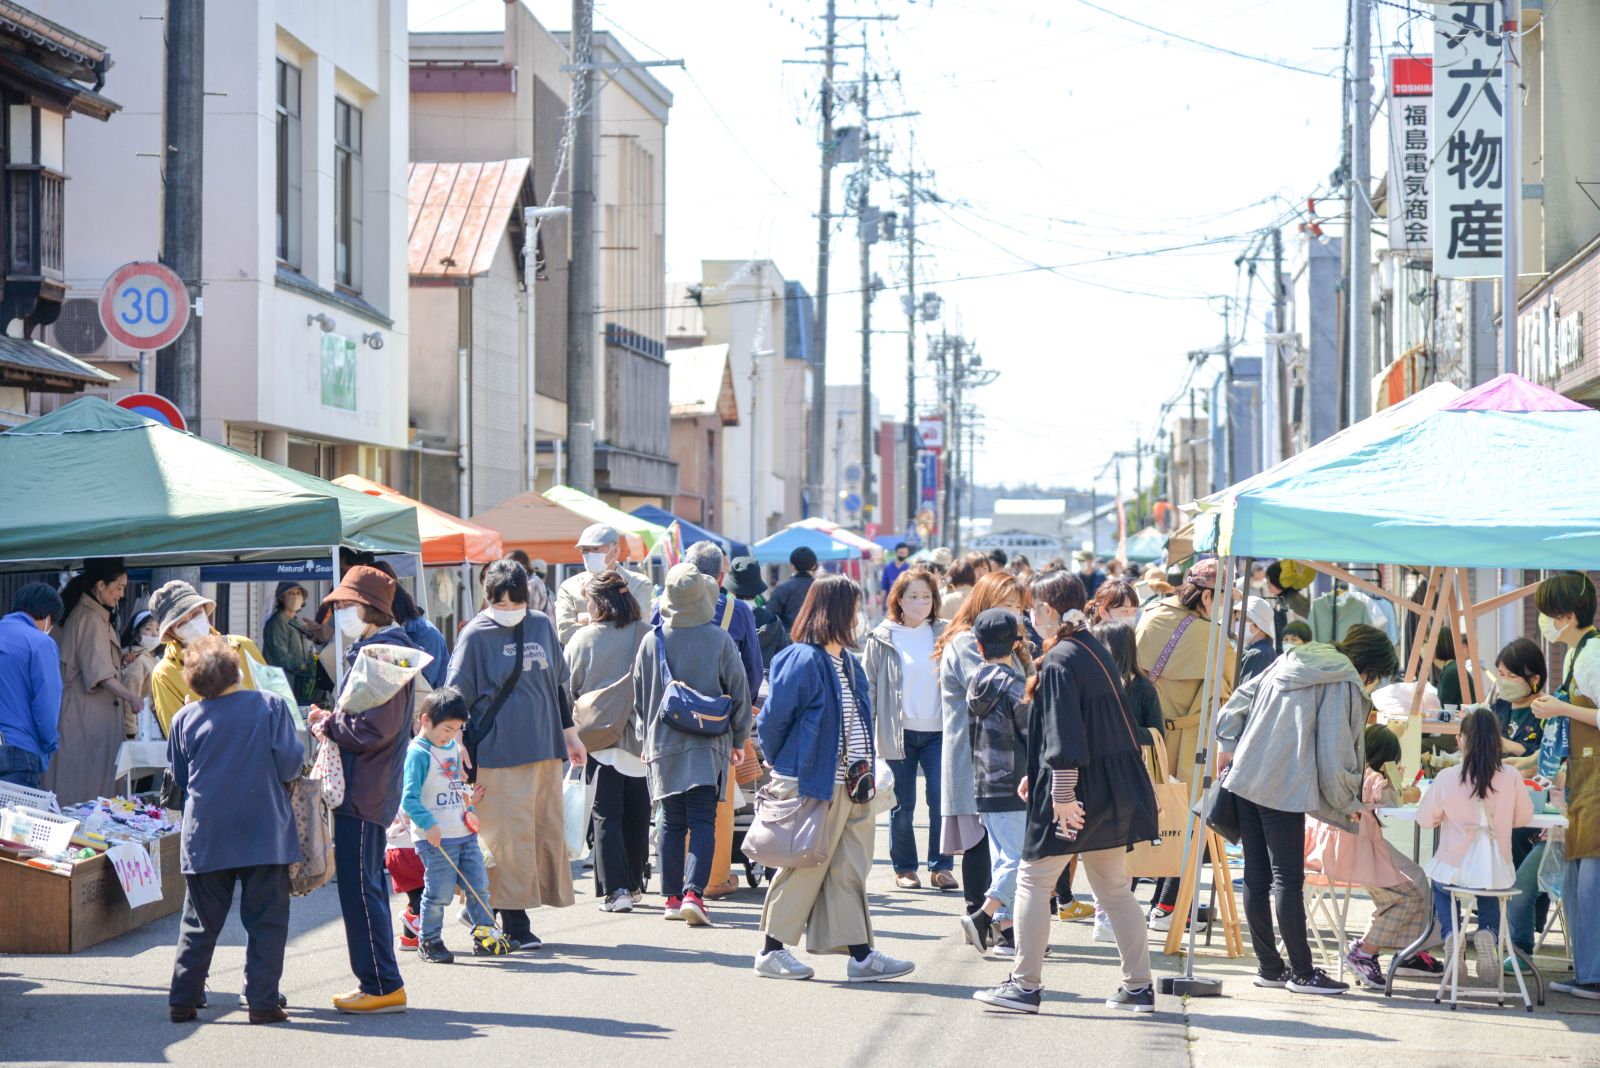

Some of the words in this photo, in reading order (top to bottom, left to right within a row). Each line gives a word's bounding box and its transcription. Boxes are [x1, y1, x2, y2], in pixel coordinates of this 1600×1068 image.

[1404, 104, 1428, 243] 福島電気商会
[121, 287, 169, 325] 30
[277, 565, 304, 573] Natural
